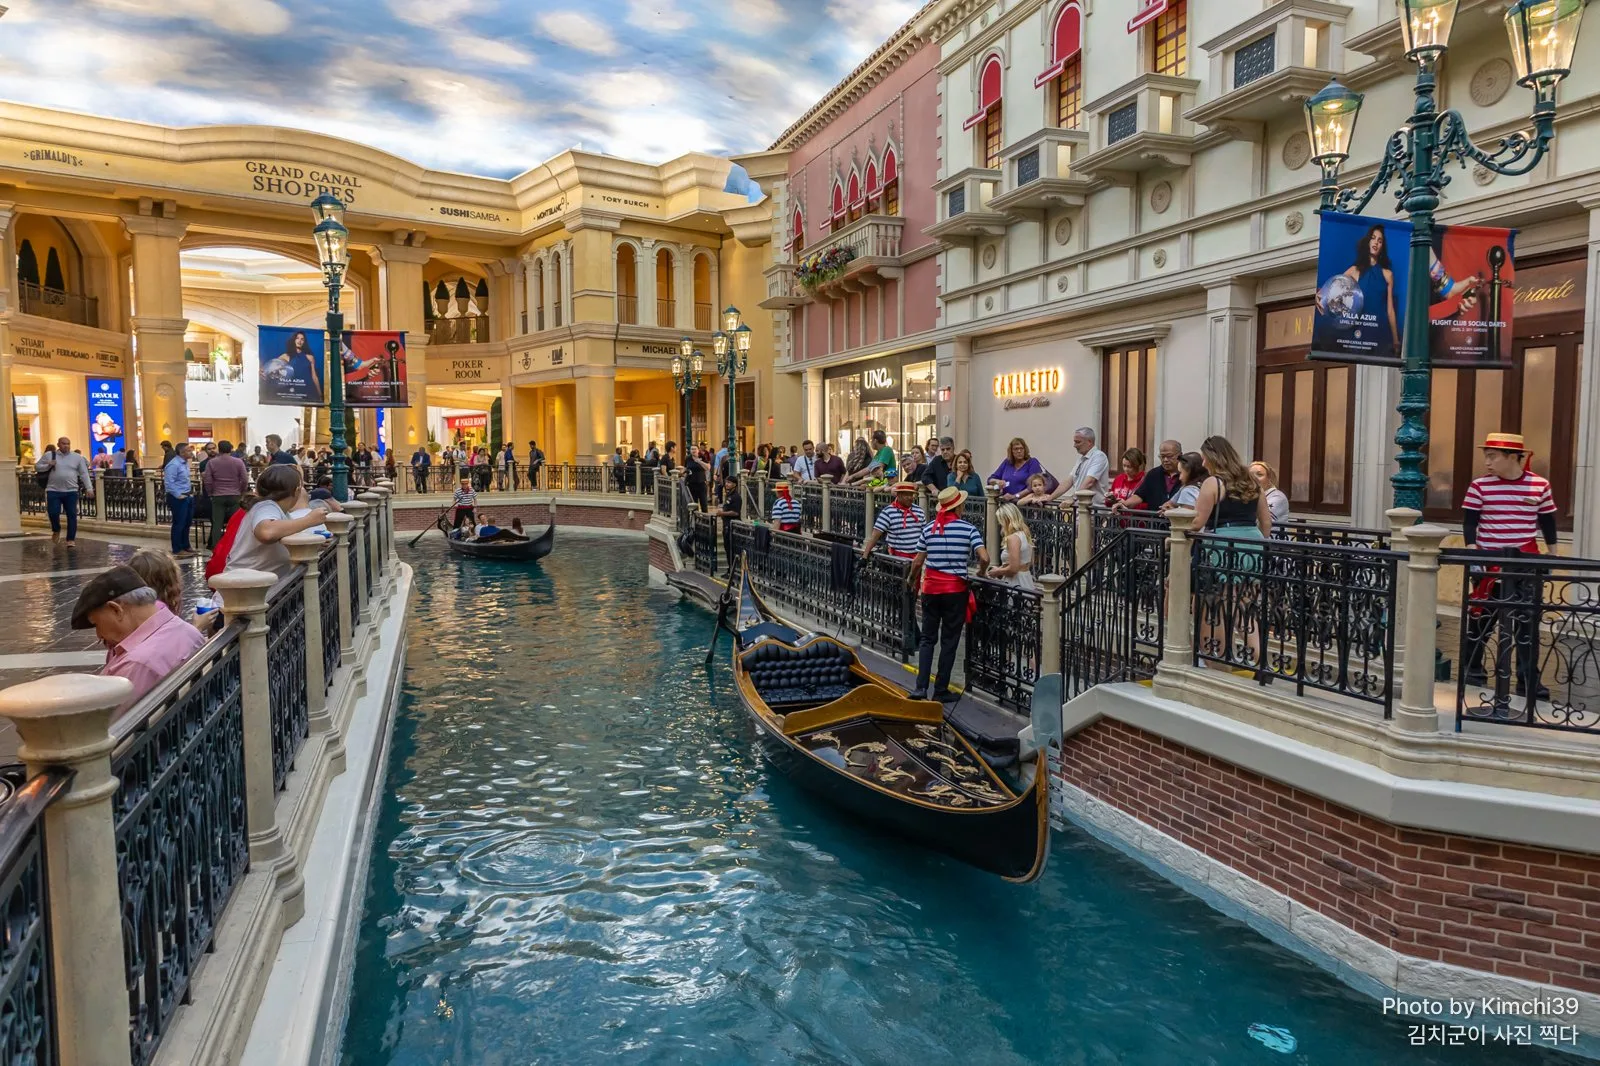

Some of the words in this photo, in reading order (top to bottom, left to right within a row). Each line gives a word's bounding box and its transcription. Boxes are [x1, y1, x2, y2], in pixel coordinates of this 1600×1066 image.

[30, 149, 77, 166] GRIMALDI'S
[246, 161, 304, 178] GRAND
[310, 171, 362, 188] CANAL
[253, 176, 354, 204] SHOPPES
[602, 196, 622, 204] TORY
[624, 200, 649, 208] BURCH
[440, 206, 500, 222] SUSHISAMBA
[536, 203, 562, 220] MONTBLANC
[1342, 310, 1359, 320] VILLA
[20, 338, 44, 348] STUART
[642, 340, 678, 354] MICHAEL
[15, 346, 51, 360] WEITZMAN
[56, 348, 90, 360] FERRAGAMO
[452, 360, 484, 369] POKER
[455, 370, 481, 379] ROOM
[994, 370, 1058, 396] CANALETTO
[460, 418, 473, 426] POKER
[474, 417, 486, 426] ROOM
